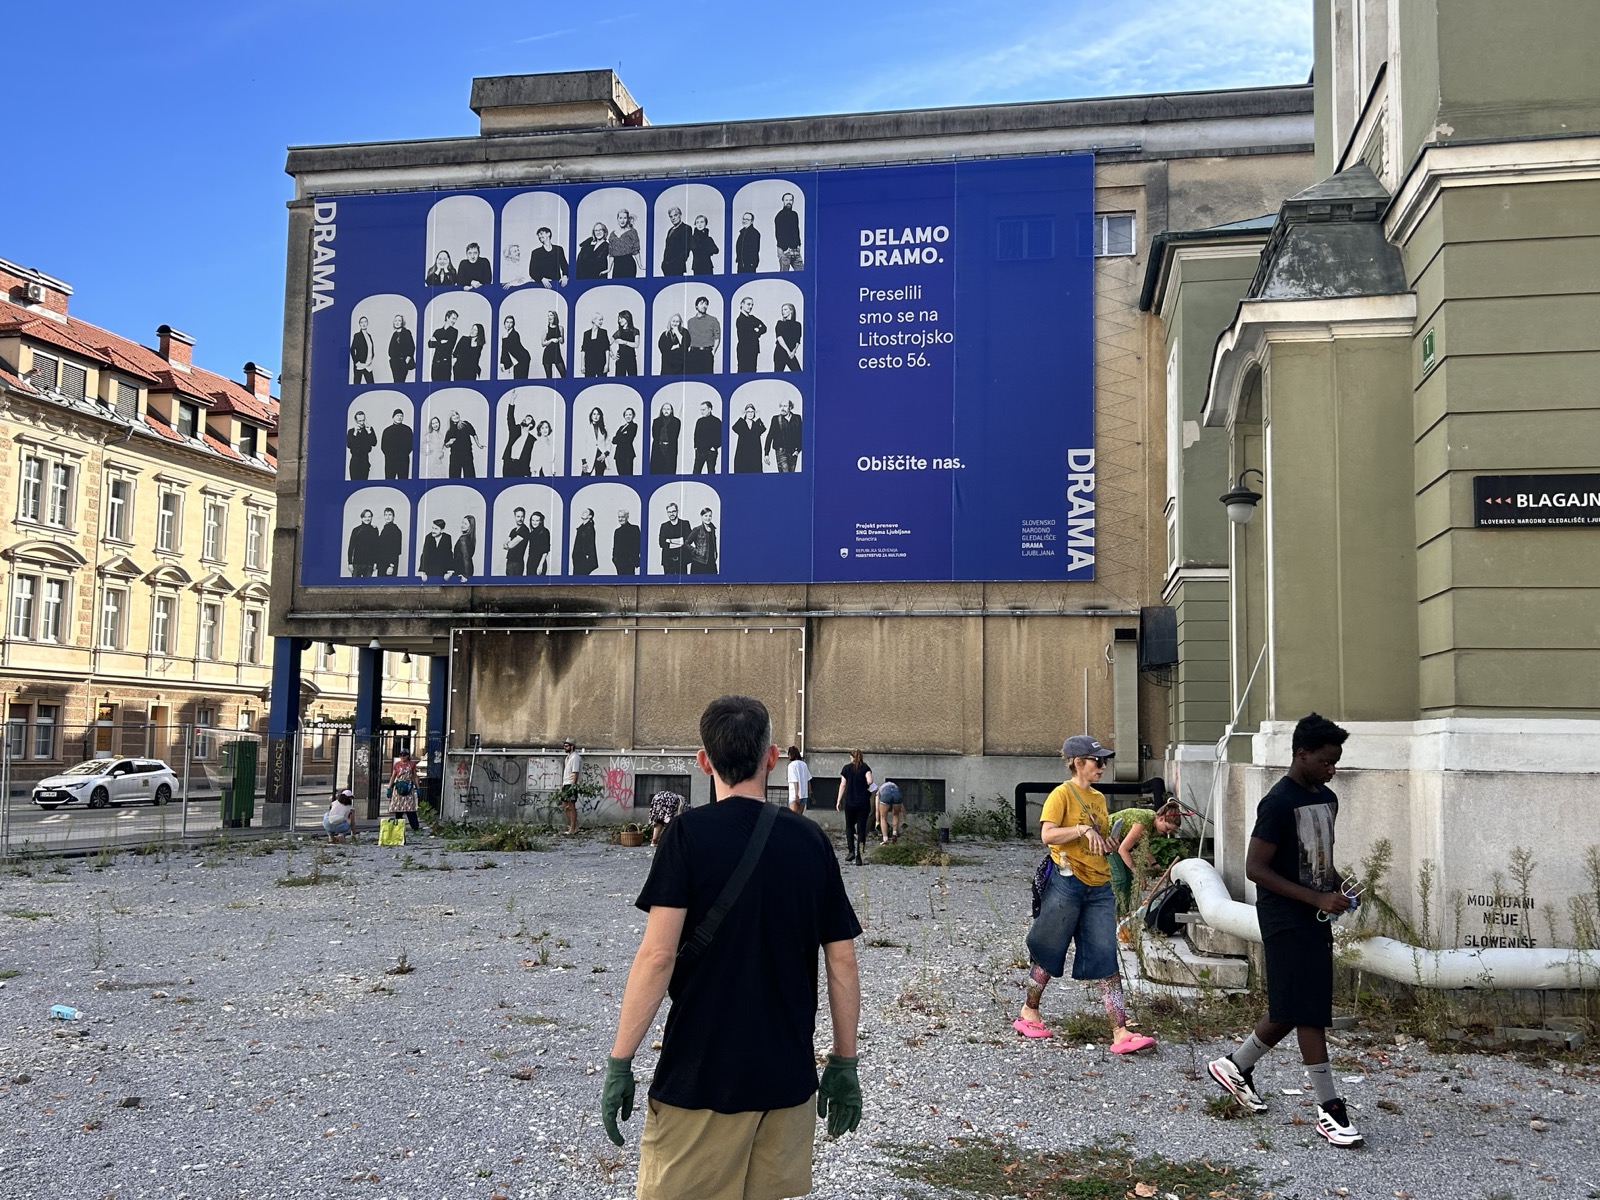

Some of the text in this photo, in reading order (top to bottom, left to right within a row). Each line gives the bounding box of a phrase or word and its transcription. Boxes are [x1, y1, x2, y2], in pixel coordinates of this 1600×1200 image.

[860, 225, 950, 246] DELAMO
[312, 202, 337, 313] DRAMA
[860, 247, 944, 267] DRAMO.
[860, 285, 922, 302] Preselili
[859, 310, 938, 324] smo se na
[859, 329, 954, 348] Litostrojsko
[858, 352, 931, 369] cesto 56.
[857, 455, 966, 471] Obiščite nas.
[1516, 493, 1600, 508] BLAGAJN
[1067, 449, 1095, 572] DRAMA
[1548, 516, 1585, 524] GLEDALIŠČE
[1483, 912, 1519, 926] NEUE
